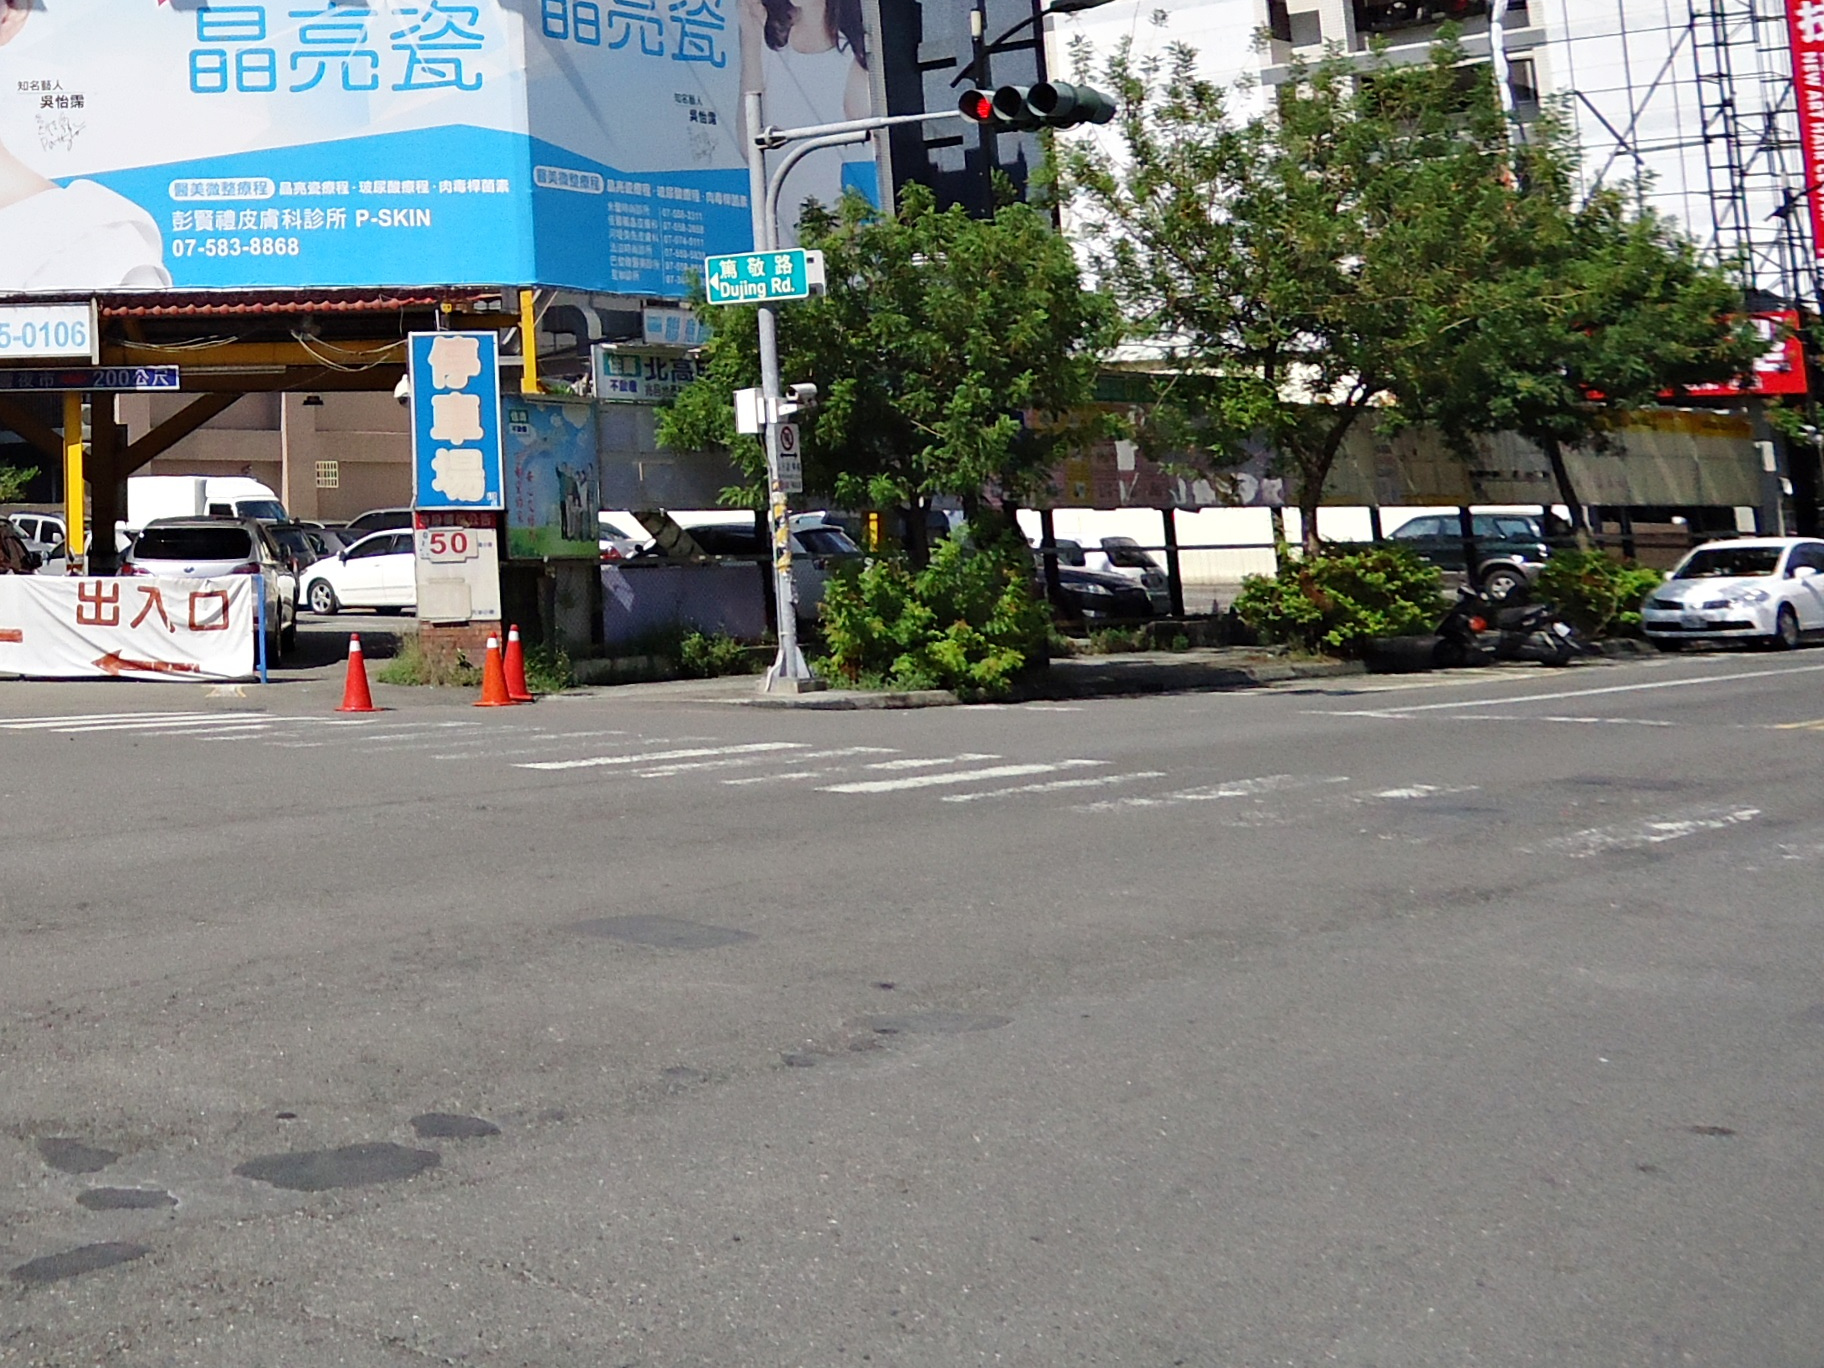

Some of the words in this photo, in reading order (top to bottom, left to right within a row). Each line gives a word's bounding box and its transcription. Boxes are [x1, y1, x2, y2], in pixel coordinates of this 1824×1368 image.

[1800, 51, 1820, 87] NEW
[17, 79, 63, 91] 知名藝人
[1806, 89, 1824, 119] ART
[174, 180, 269, 198] 醫美微整療程
[355, 209, 431, 228] P-SKIN
[172, 238, 300, 257] 07-583-8868
[719, 254, 794, 279] 篤敬路
[720, 280, 767, 300] Dujing
[771, 277, 795, 294] Rd.
[430, 533, 467, 554] 50
[77, 580, 229, 633] 出入口
